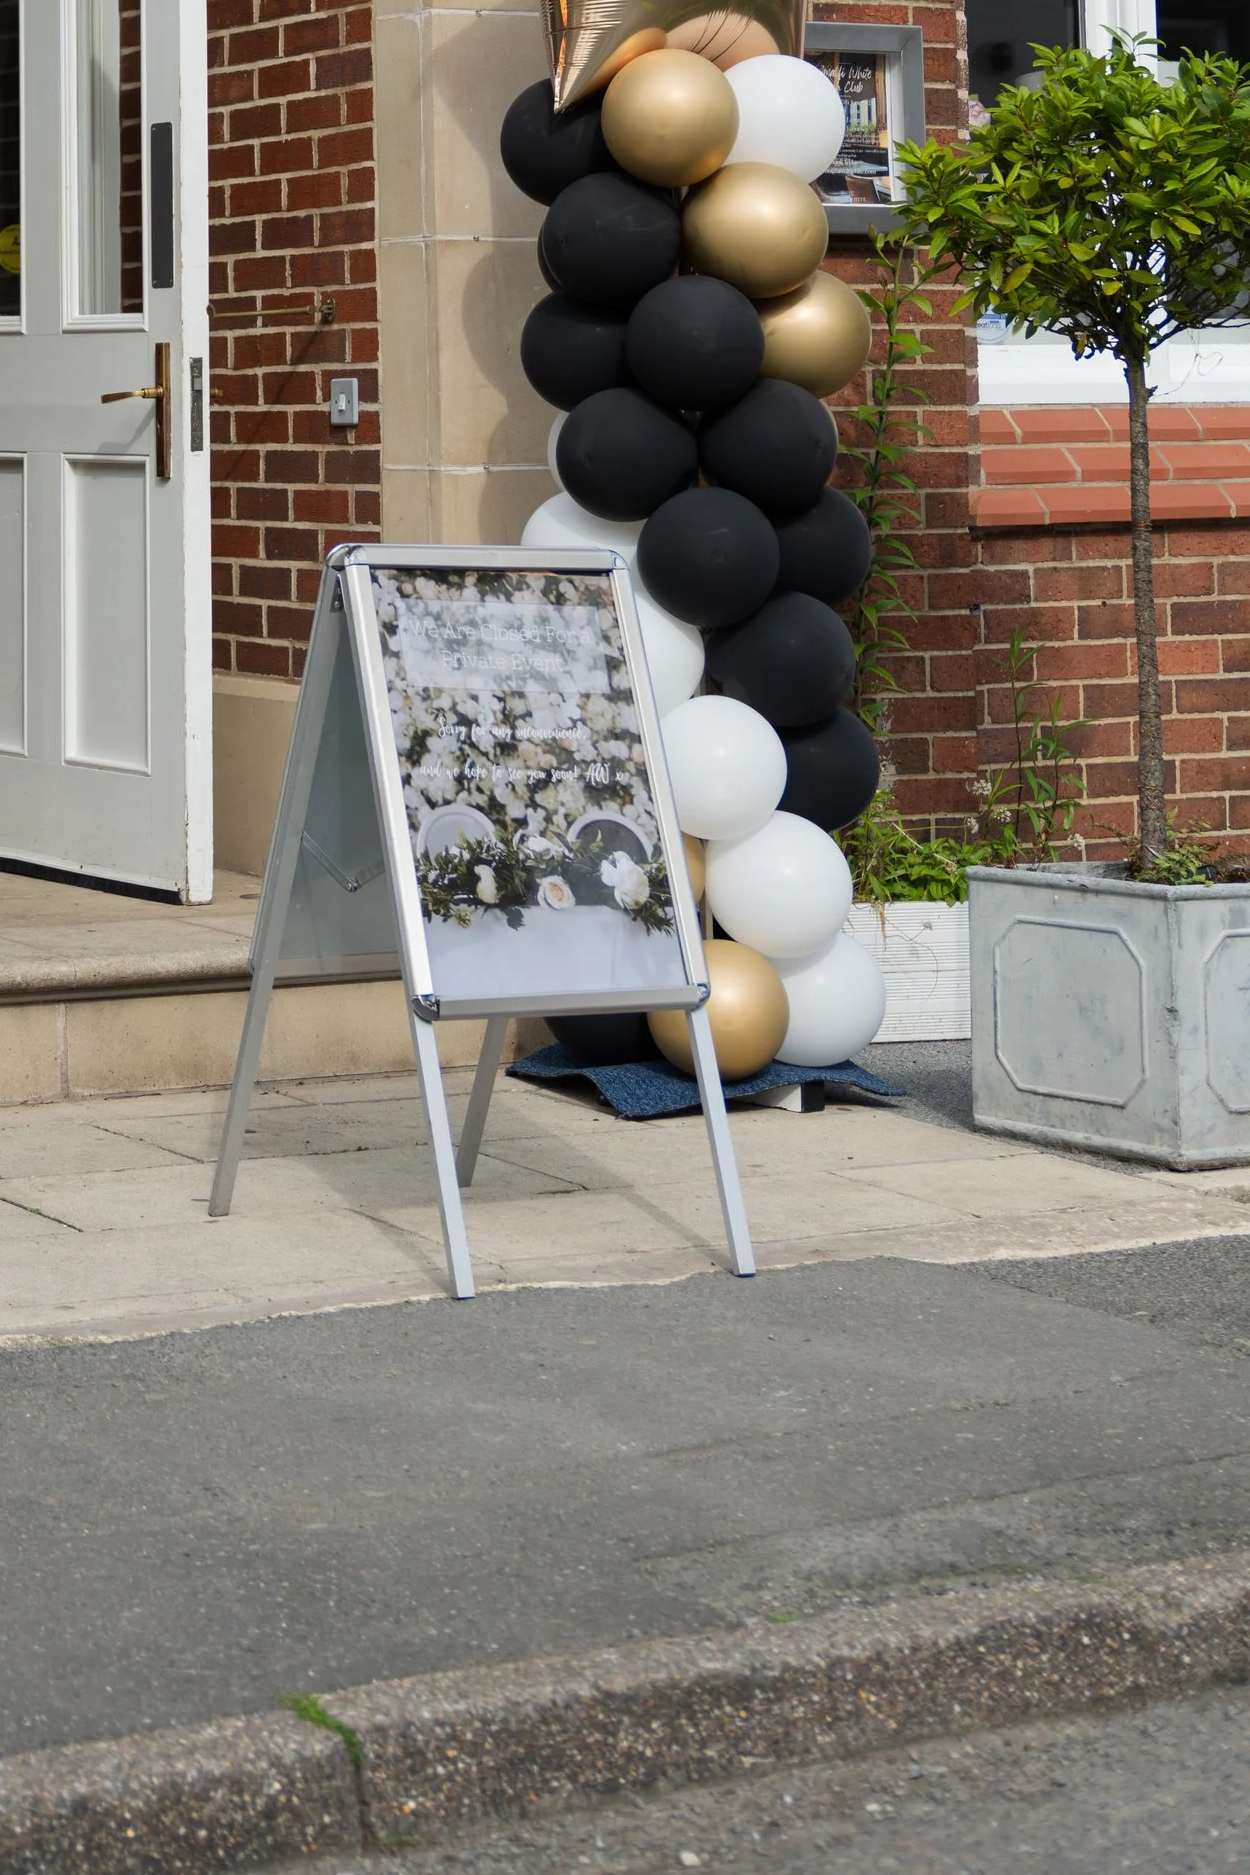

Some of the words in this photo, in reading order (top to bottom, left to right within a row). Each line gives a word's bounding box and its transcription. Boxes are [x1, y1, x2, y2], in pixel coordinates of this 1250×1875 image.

[848, 66, 873, 80] White
[843, 80, 864, 94] Club
[410, 620, 439, 638] We
[444, 622, 476, 640] Are
[480, 623, 541, 642] Closed
[545, 626, 576, 643] For
[580, 633, 591, 644] a
[441, 650, 506, 670] Private
[510, 653, 563, 671] Event
[438, 716, 467, 740] Sorry
[471, 724, 486, 741] for
[491, 728, 512, 742] any
[419, 758, 441, 776] and
[446, 766, 459, 777] we
[464, 757, 489, 780] hope
[491, 764, 503, 778] to
[508, 768, 522, 780] see
[528, 770, 546, 784] you
[551, 764, 578, 782] soon!
[585, 763, 611, 785] AW
